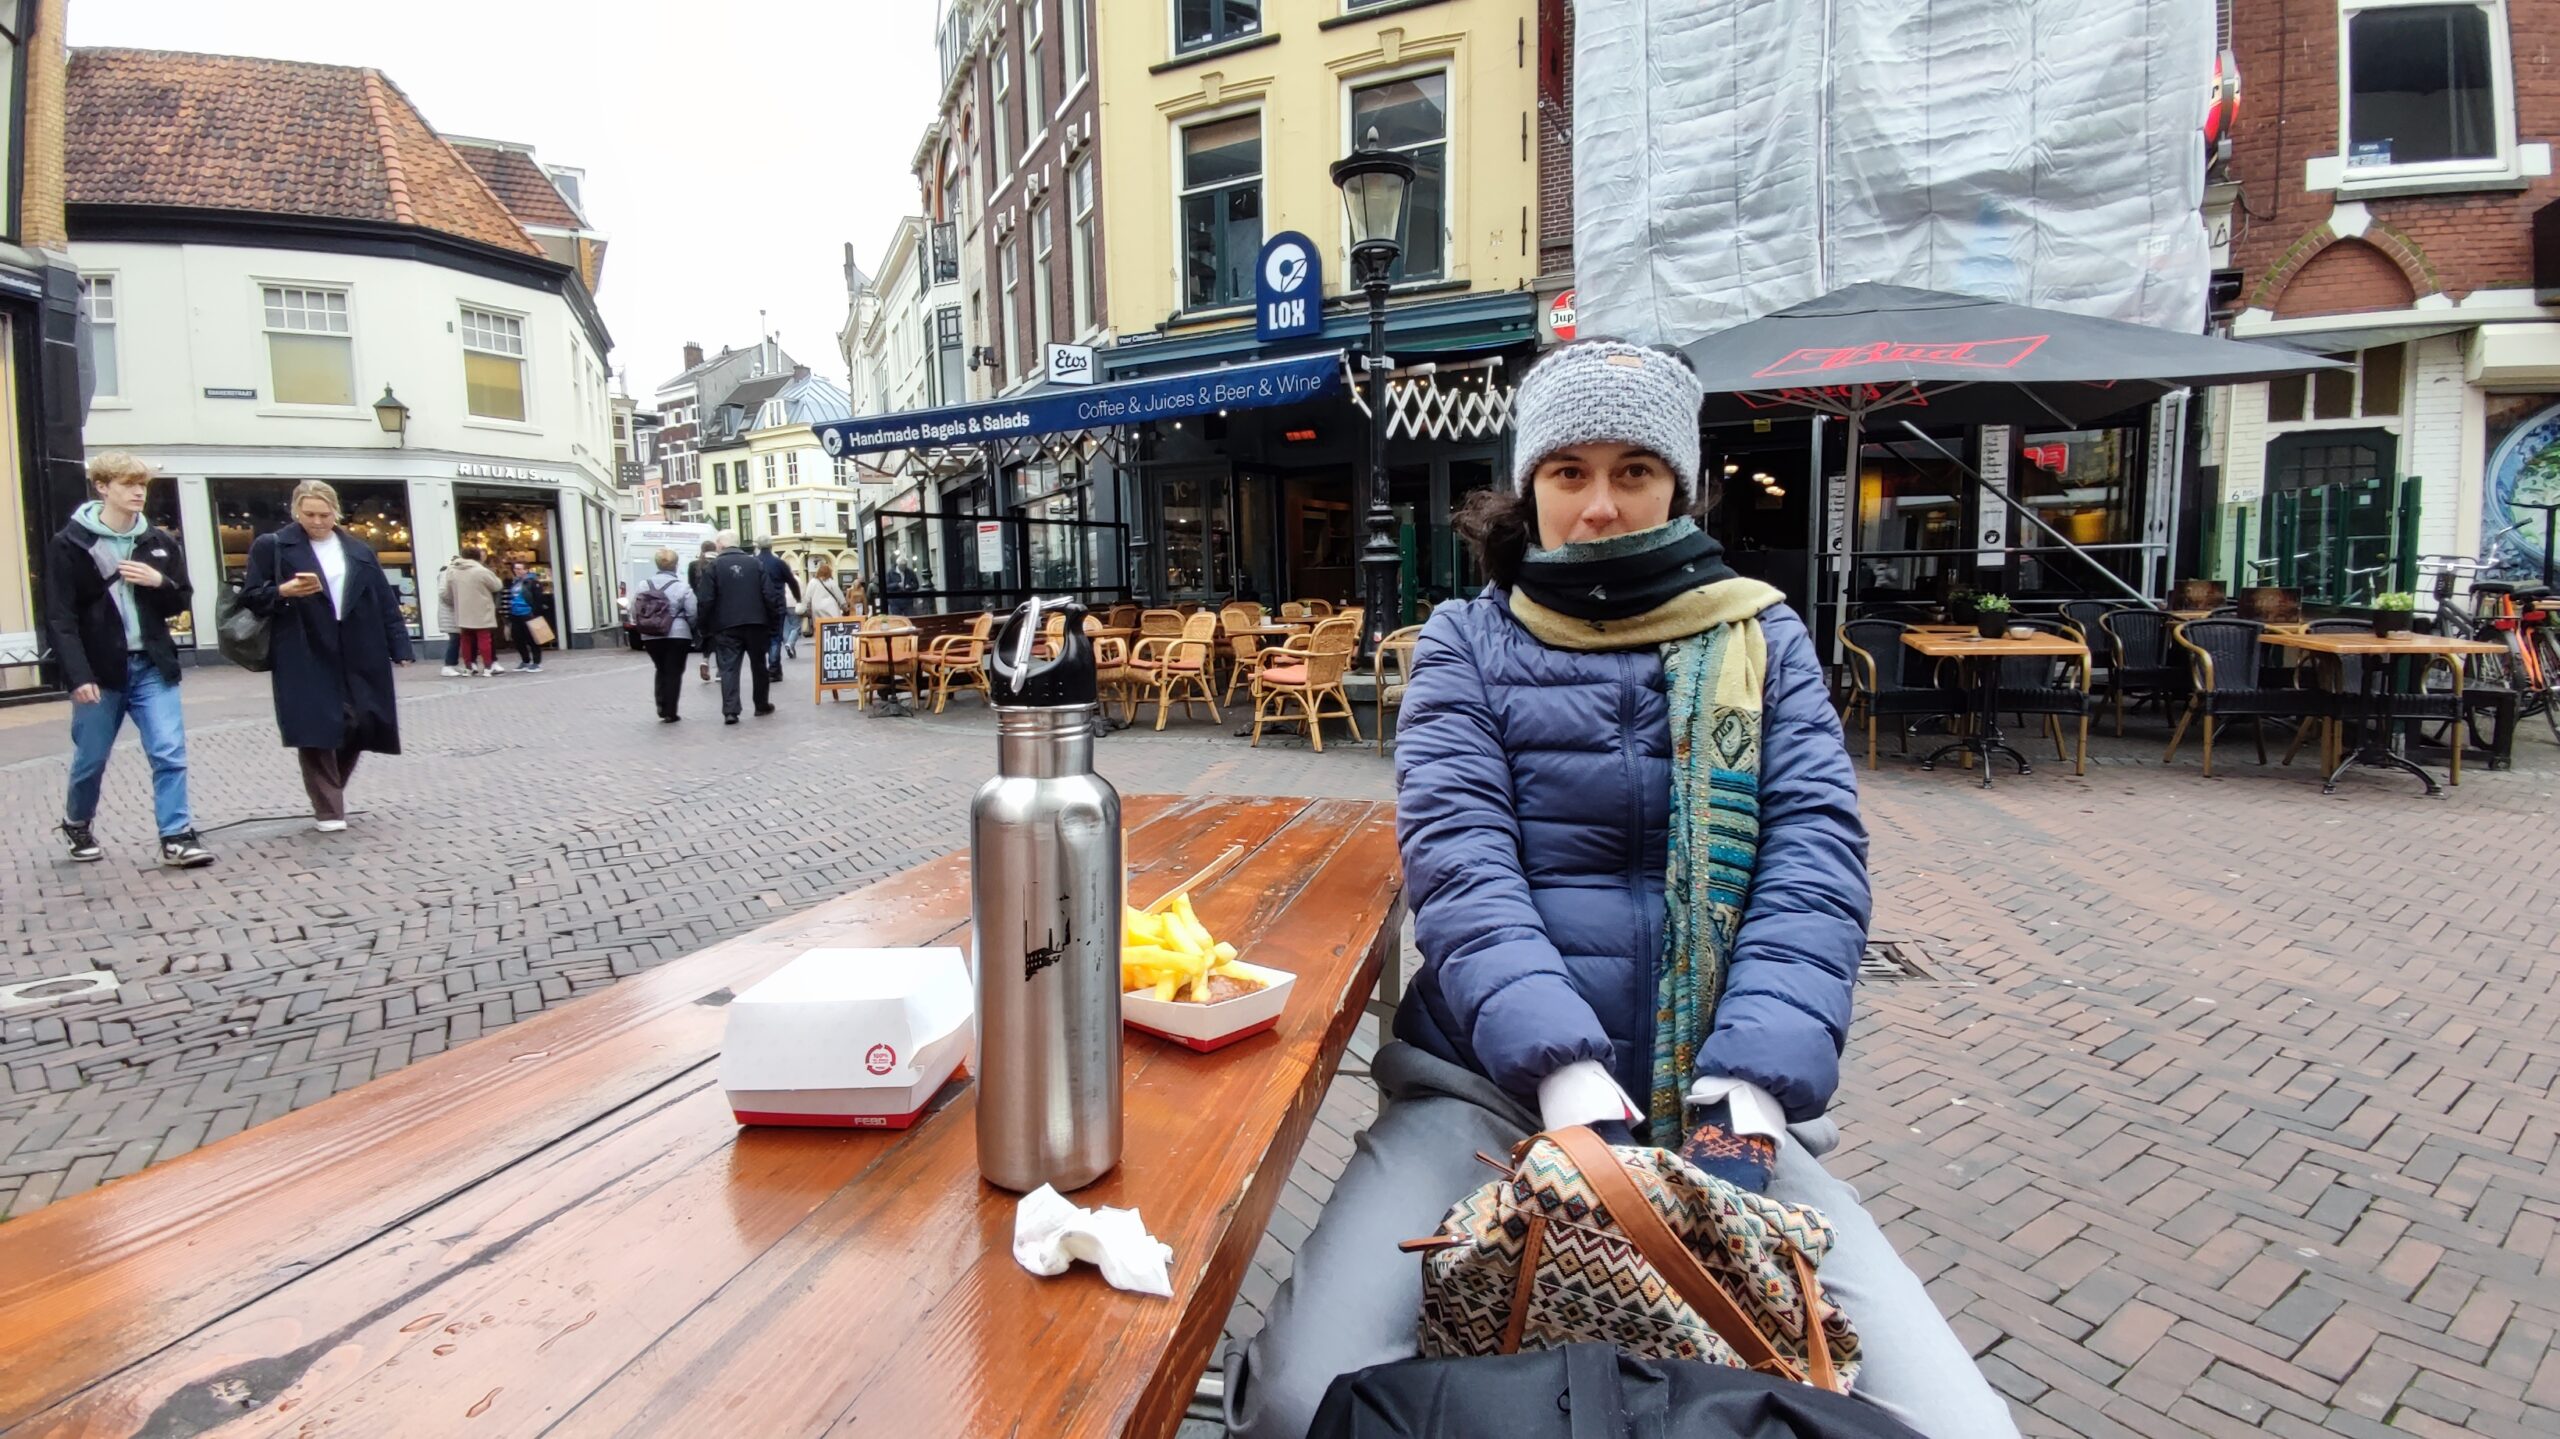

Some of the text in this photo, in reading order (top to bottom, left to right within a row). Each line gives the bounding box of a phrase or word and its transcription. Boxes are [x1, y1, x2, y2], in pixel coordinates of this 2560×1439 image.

[1269, 298, 1305, 330] LOX
[1553, 312, 1574, 324] Jup
[1055, 349, 1088, 369] Etos
[1801, 342, 1976, 370] Bud
[1078, 374, 1322, 420] Coffee & Juices & Beer & Wine
[850, 411, 1030, 448] Handmade Bagels & Salads
[2231, 489, 2240, 501] 6
[823, 630, 854, 652] KOFFI
[854, 1117, 887, 1126] FEBO
